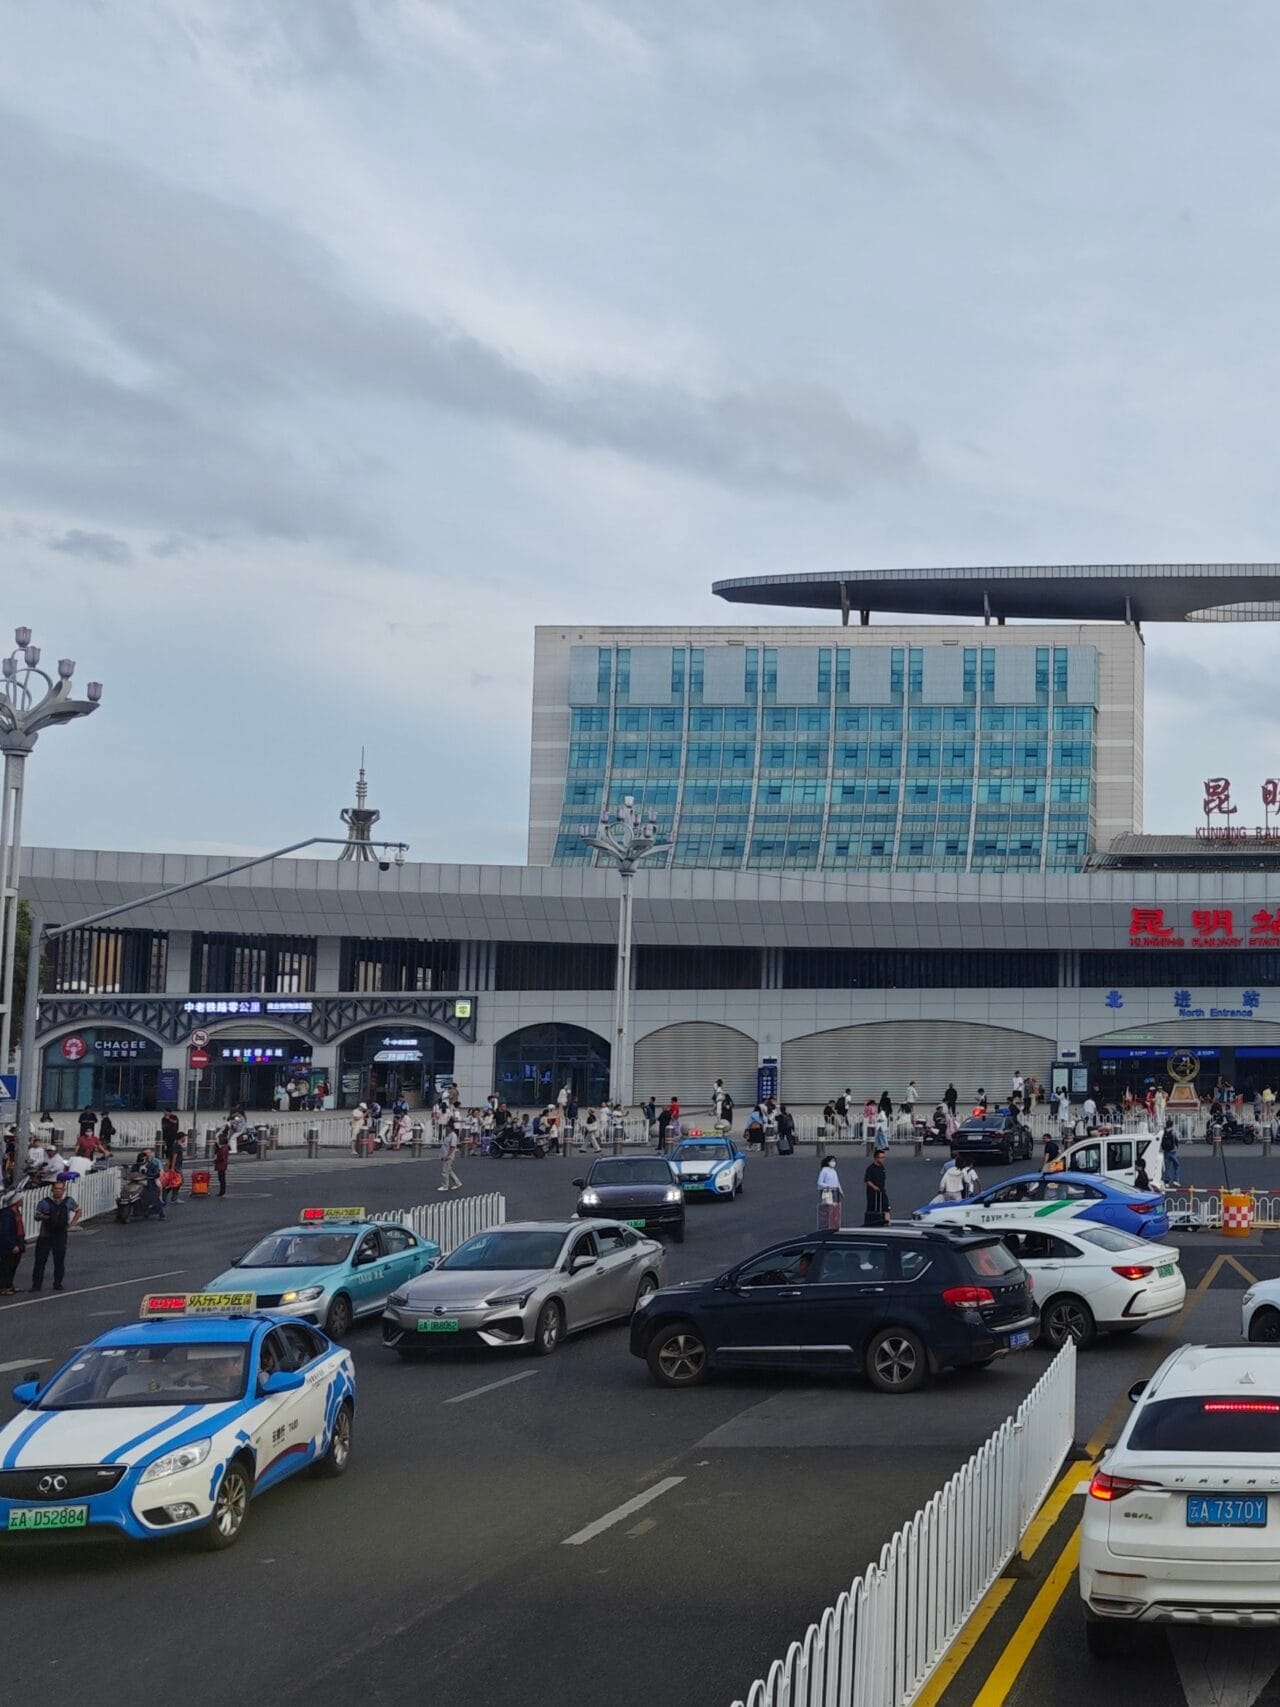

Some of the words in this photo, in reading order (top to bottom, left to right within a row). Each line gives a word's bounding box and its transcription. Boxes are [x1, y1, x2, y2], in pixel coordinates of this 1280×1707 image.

[1195, 827, 1247, 840] KUNMING
[1178, 1008, 1204, 1018] North
[1210, 1008, 1253, 1017] Entrance
[94, 1040, 147, 1049] CHAGEE
